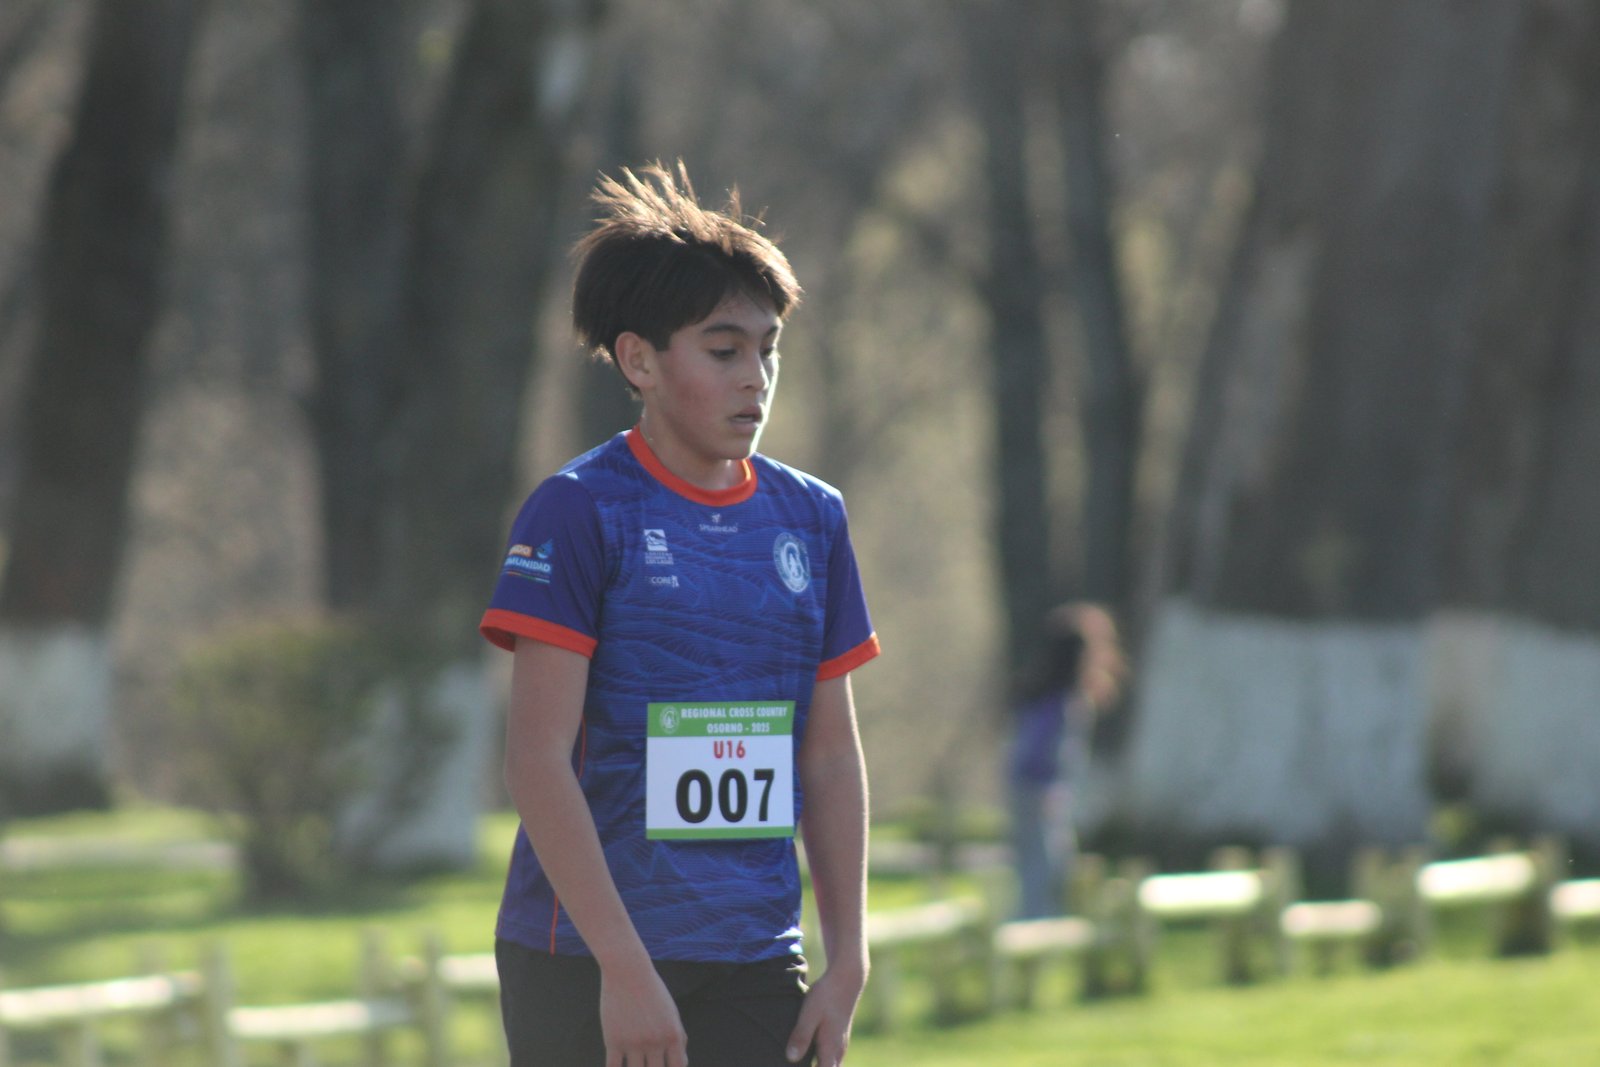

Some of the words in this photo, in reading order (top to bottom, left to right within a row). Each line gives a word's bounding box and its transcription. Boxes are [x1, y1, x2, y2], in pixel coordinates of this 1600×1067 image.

[681, 707, 727, 719] REGIONAL
[729, 706, 754, 718] CROSS
[756, 706, 788, 717] COUNTRY
[706, 722, 743, 733] OSORNO
[751, 722, 770, 733] 2025
[713, 740, 746, 759] U16
[676, 768, 775, 824] 007
